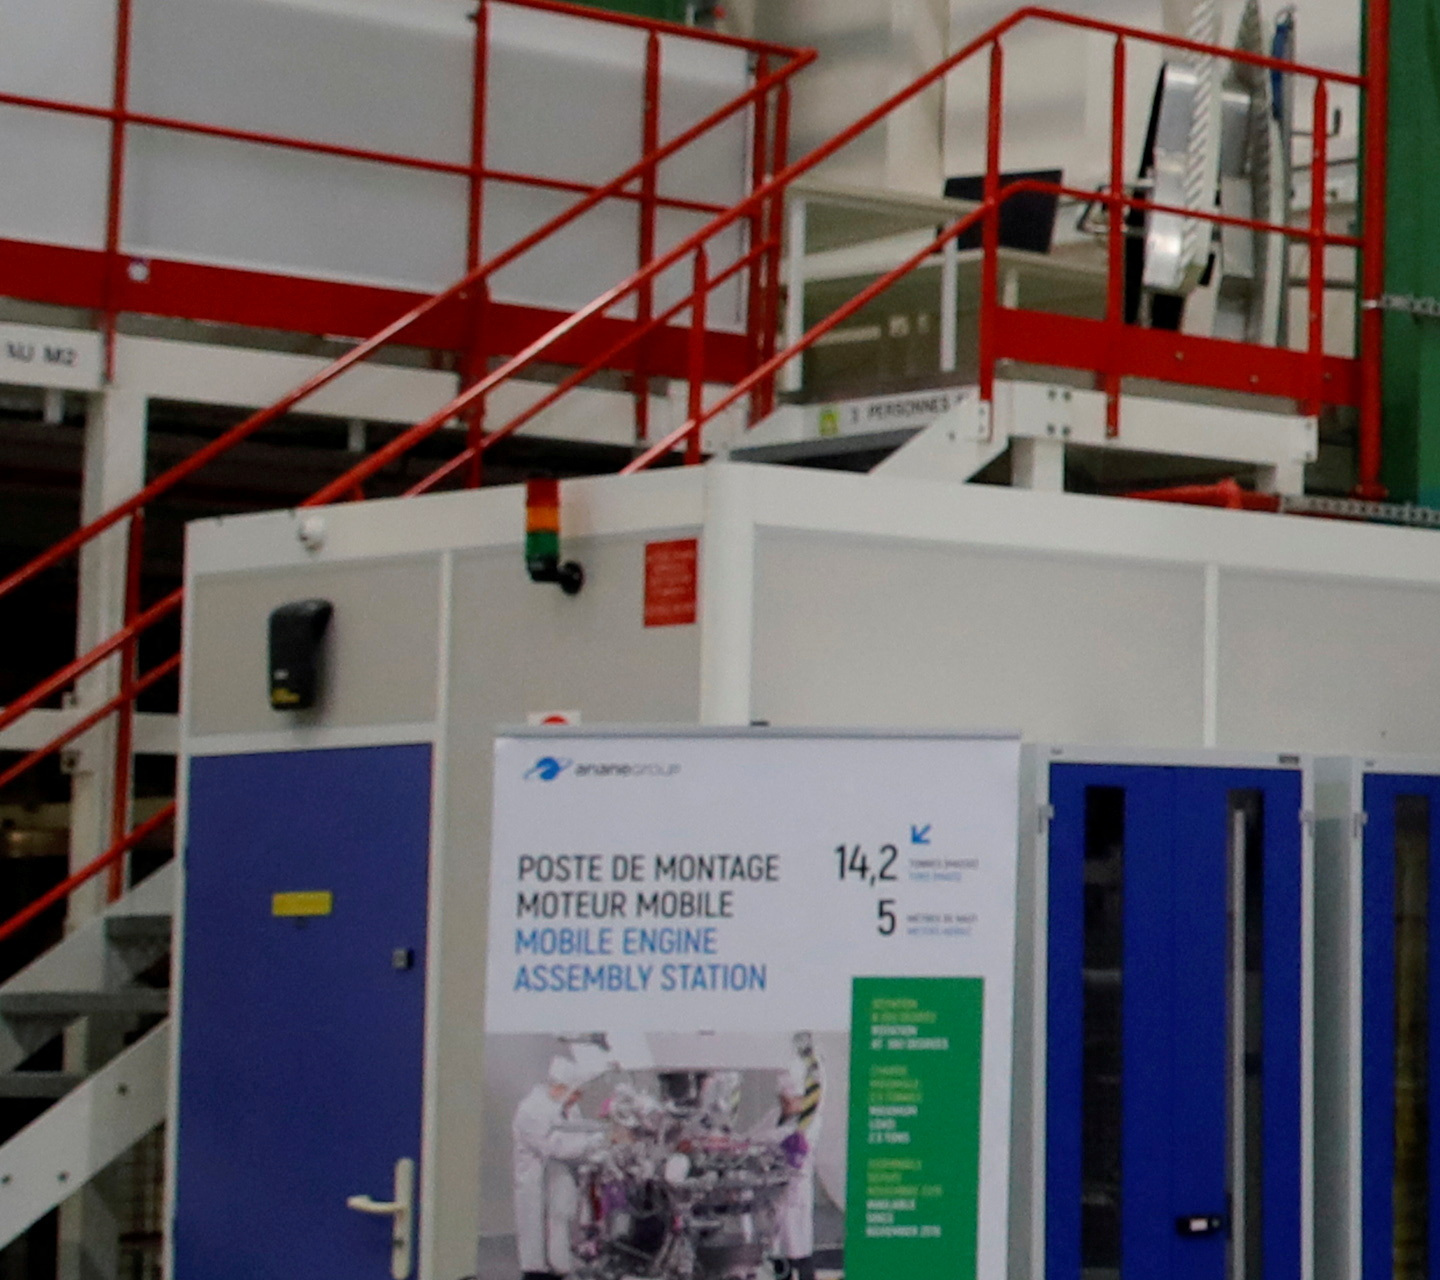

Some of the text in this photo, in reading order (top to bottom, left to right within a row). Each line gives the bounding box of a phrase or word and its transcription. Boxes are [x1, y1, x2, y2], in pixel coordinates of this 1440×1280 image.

[518, 854, 780, 882] POSTE DE MONTAGE
[834, 843, 898, 887] 14,2
[516, 891, 734, 918] MOTEUR MOBILE
[877, 899, 897, 936] 5
[514, 927, 718, 955] MOBILE ENGINE
[513, 963, 768, 992] ASSEMBLY STATION
